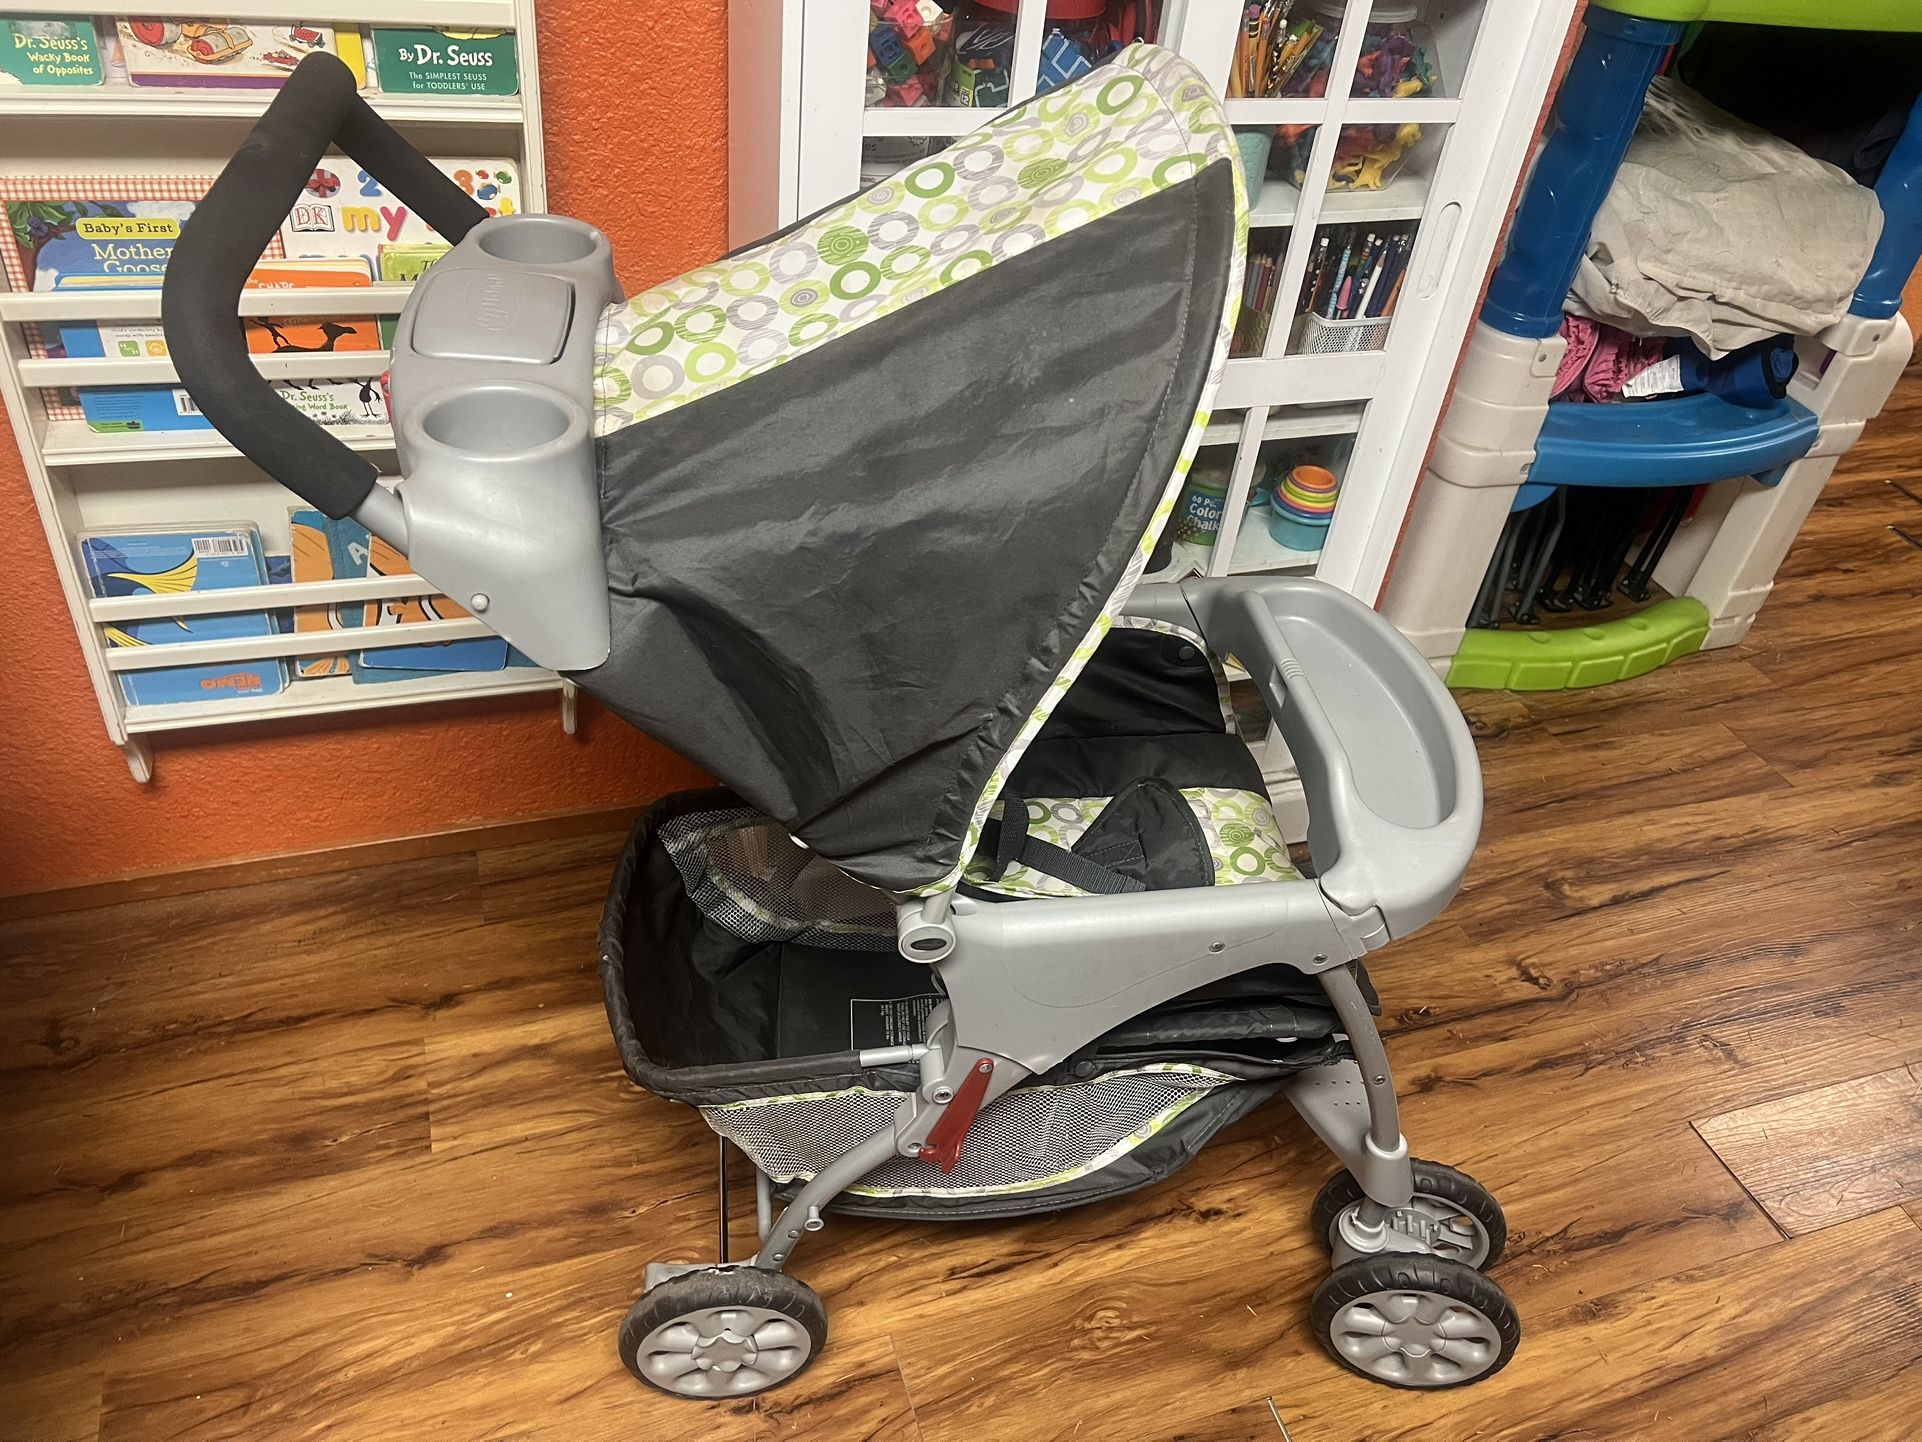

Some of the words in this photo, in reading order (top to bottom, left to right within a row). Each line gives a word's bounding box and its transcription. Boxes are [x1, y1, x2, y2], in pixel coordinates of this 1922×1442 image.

[12, 33, 36, 49] Dr.
[39, 36, 88, 51] Seuss's
[27, 52, 61, 64] Wacky
[63, 52, 90, 62] Book
[399, 48, 414, 62] By
[413, 44, 443, 65] Dr.
[447, 44, 493, 67] Seuss
[33, 65, 44, 74] of
[47, 64, 94, 77] Opposites
[409, 71, 423, 80] The
[425, 72, 460, 81] SIMPLEST
[463, 73, 487, 81] SEUSS
[412, 81, 424, 89] for
[471, 82, 486, 91] USE
[294, 207, 328, 225] DK
[83, 223, 133, 235] Baby's
[136, 223, 174, 233] First
[341, 206, 406, 241] my
[91, 243, 174, 260] Mother
[281, 390, 297, 401] Dr.
[299, 391, 335, 402] Seuss's
[307, 401, 327, 410] Word
[329, 402, 348, 410] Book
